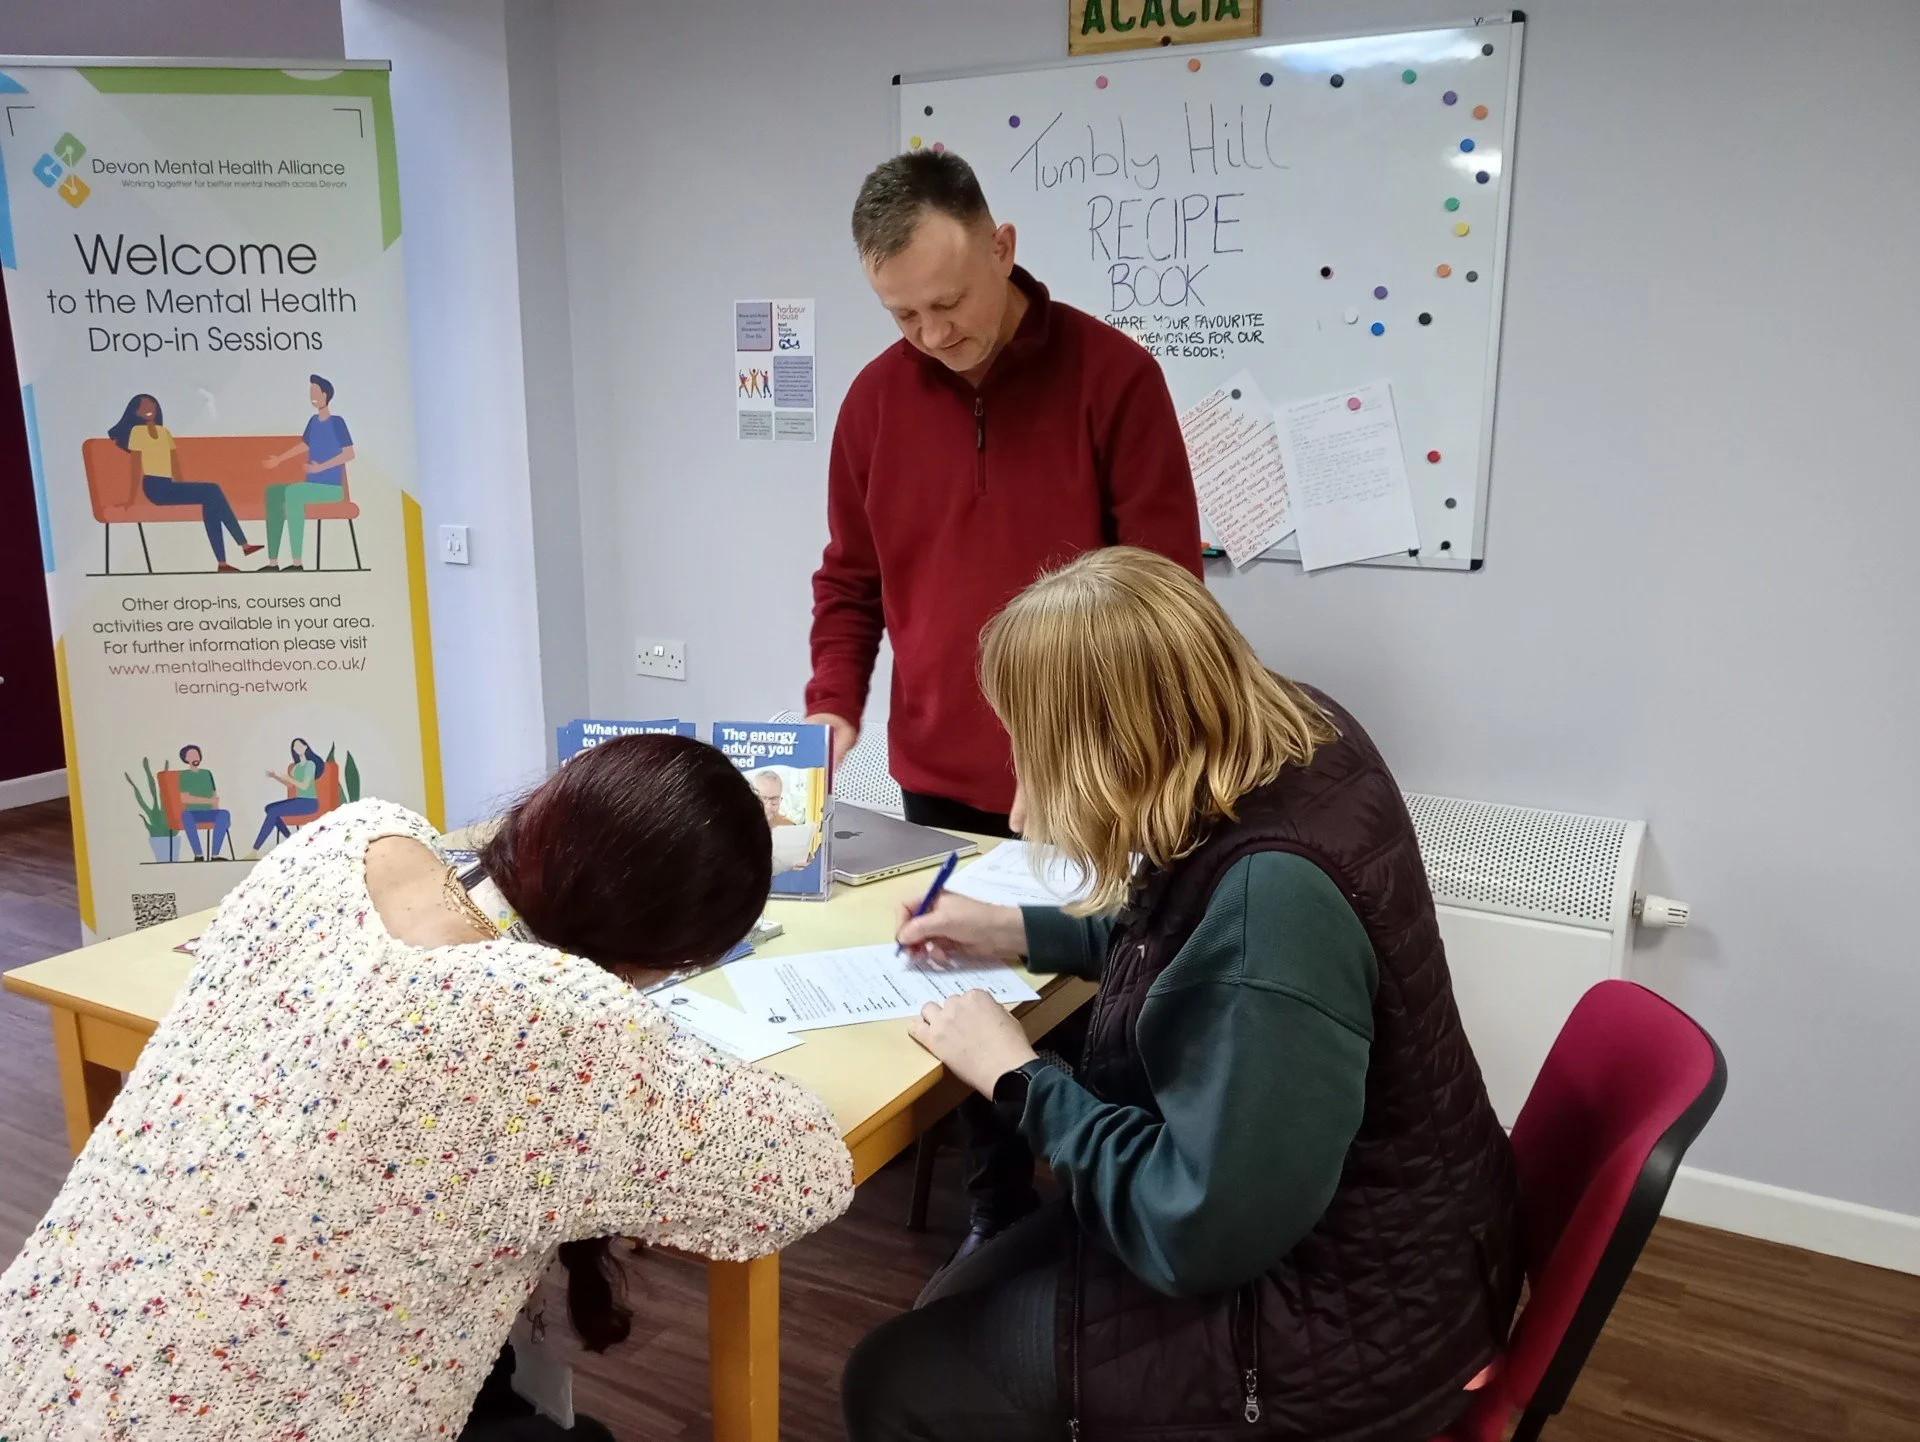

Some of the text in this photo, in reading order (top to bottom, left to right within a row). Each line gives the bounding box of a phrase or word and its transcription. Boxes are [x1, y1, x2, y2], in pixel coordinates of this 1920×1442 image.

[1011, 102, 1290, 191] Tumbly Hill
[92, 159, 345, 175] Devon Mental Health Alliance
[1087, 193, 1244, 262] RECIPE
[74, 233, 317, 276] Welcome
[1108, 264, 1209, 312] BOOK
[47, 287, 356, 314] to the Mental Health
[1195, 313, 1265, 330] FAVOURITE
[89, 326, 323, 357] Drop-in Sessions
[1208, 331, 1234, 344] FOR
[1237, 329, 1265, 344] OUR
[122, 595, 341, 613] Other drop-ins, courses and
[93, 616, 375, 634] activities are available in your area.
[104, 636, 368, 654] For further information please visit
[109, 657, 366, 675] www.mentalhealthdevon.co.uk/
[175, 679, 308, 696] learning-network
[583, 723, 617, 736] What
[722, 728, 798, 745] The energy
[582, 737, 597, 748] to
[722, 742, 793, 758] advice you
[731, 756, 755, 768] eed
